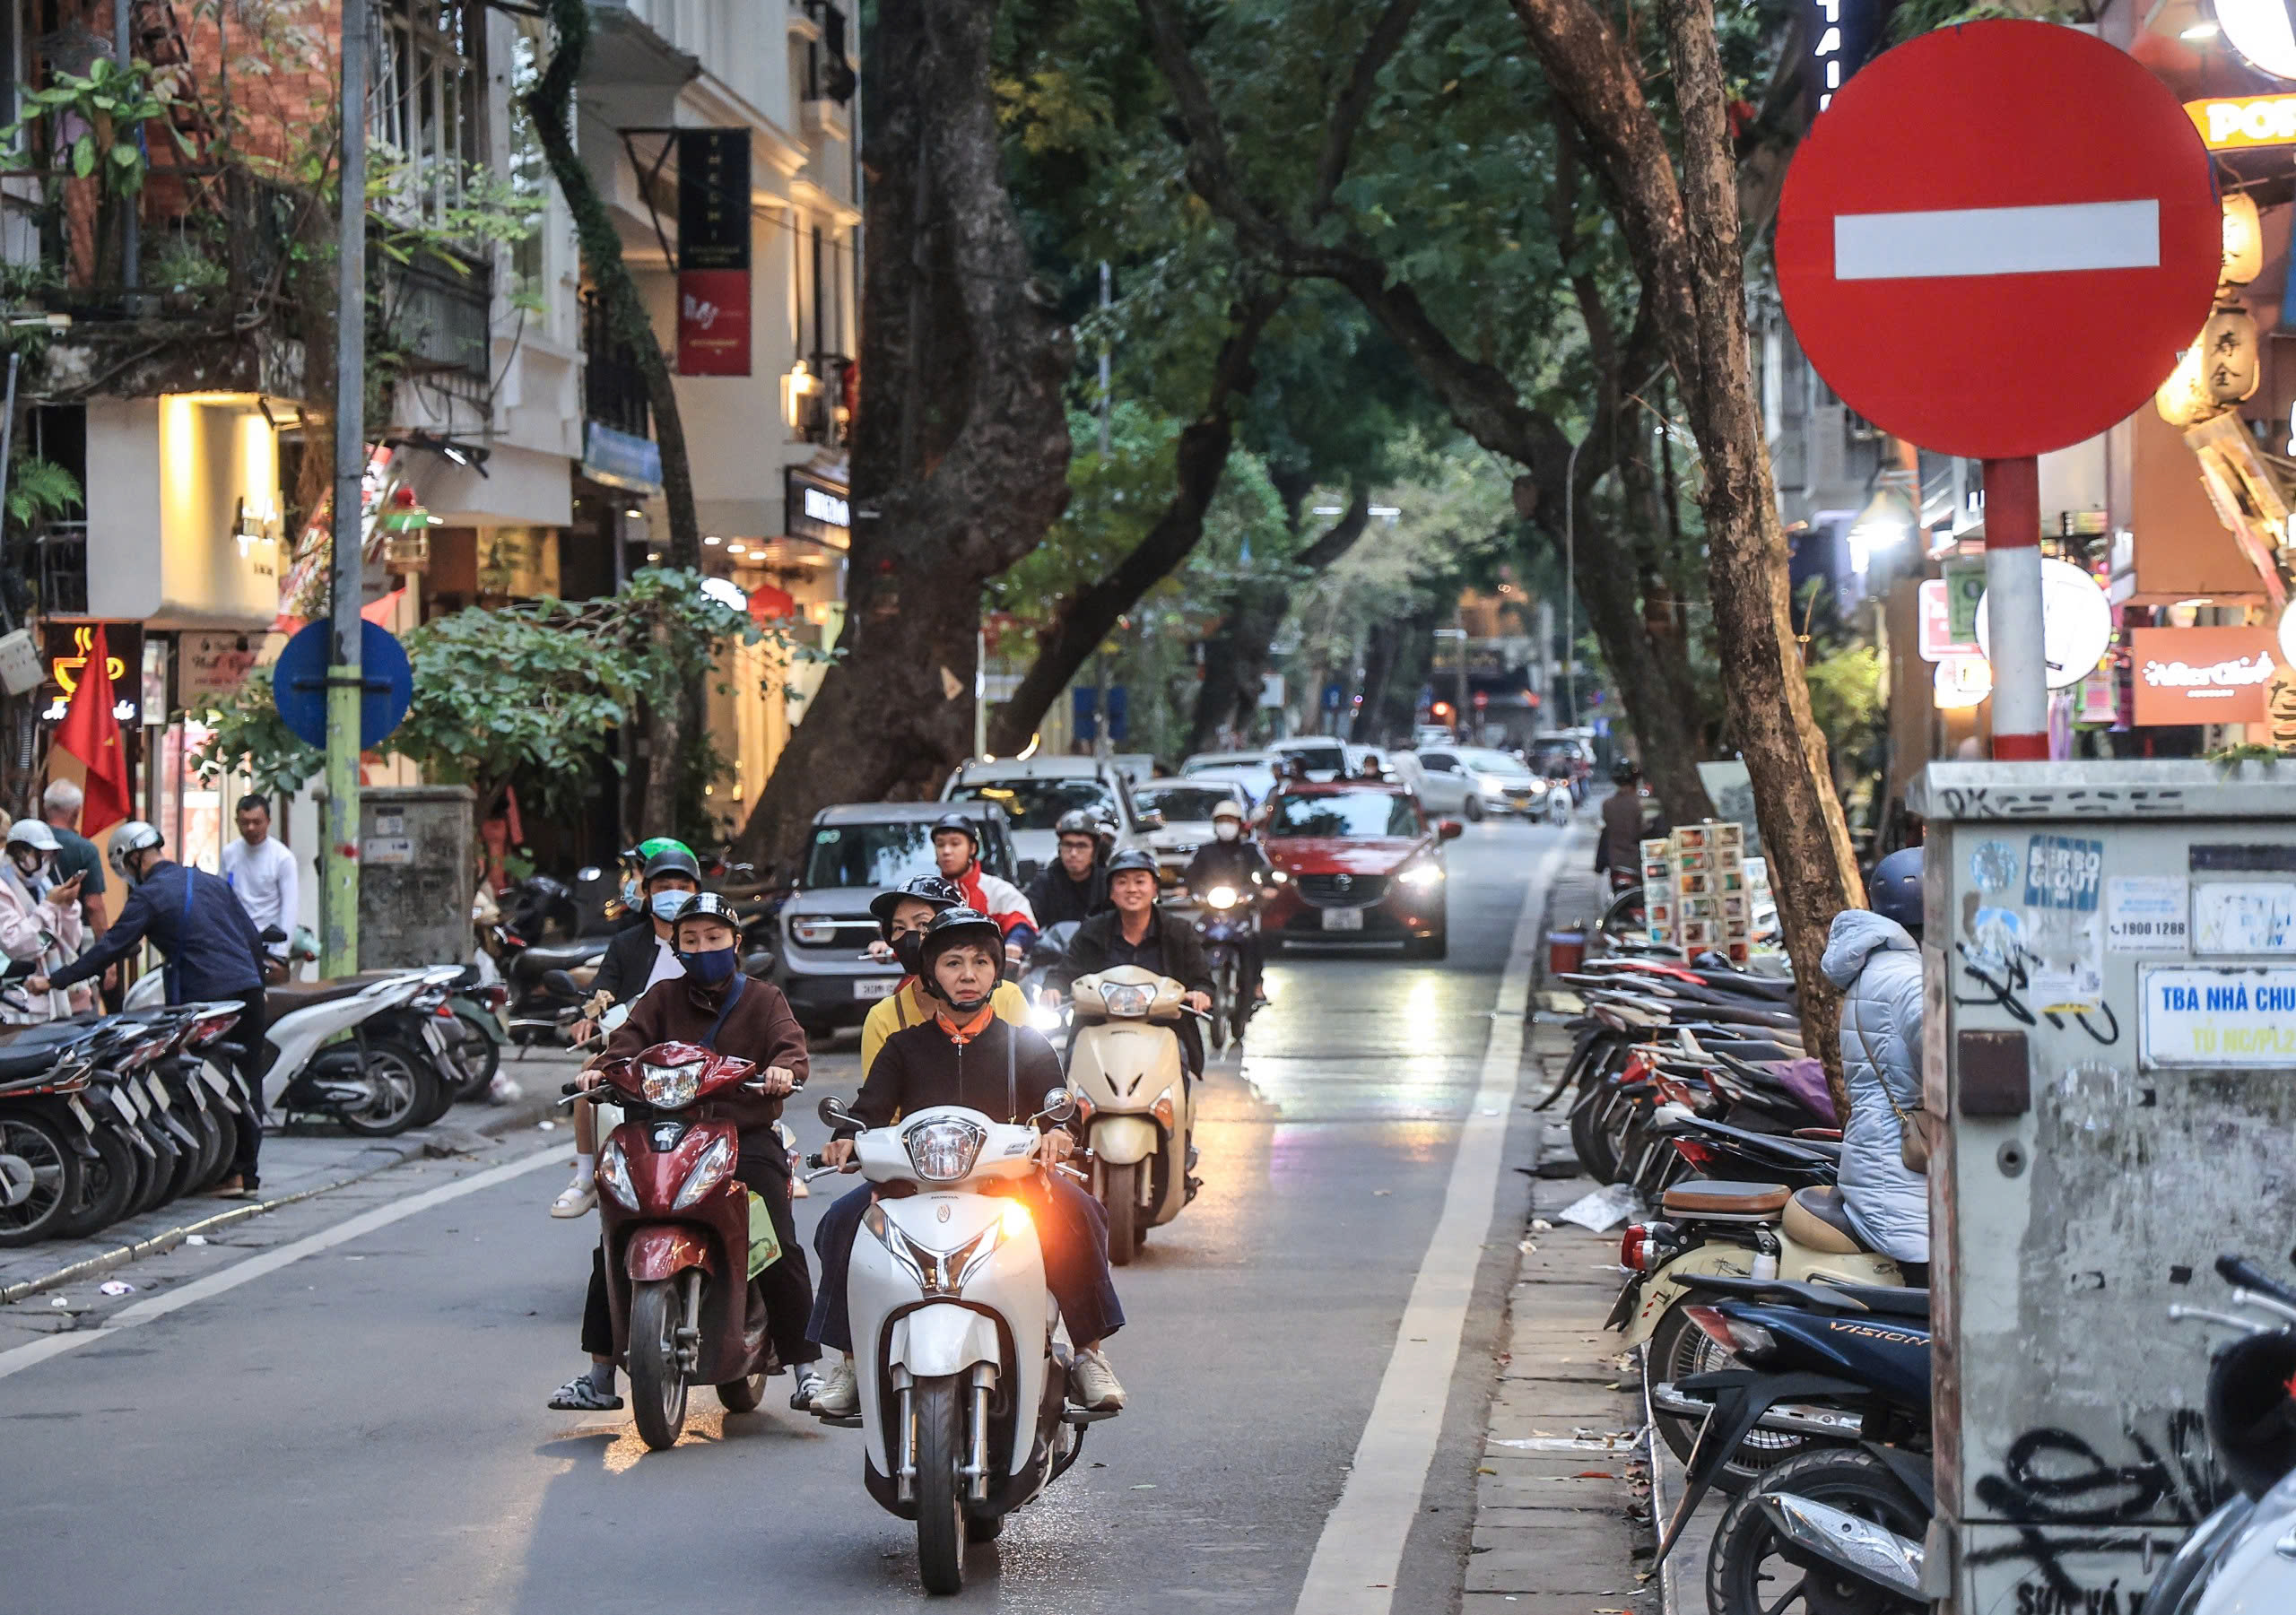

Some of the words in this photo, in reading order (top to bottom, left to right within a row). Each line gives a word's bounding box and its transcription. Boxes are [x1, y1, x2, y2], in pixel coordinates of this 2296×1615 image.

[2155, 923, 2185, 934] 1288
[2161, 986, 2199, 1012] TBA
[2206, 981, 2248, 1012] NHÀ
[1830, 1321, 1930, 1346] VISION
